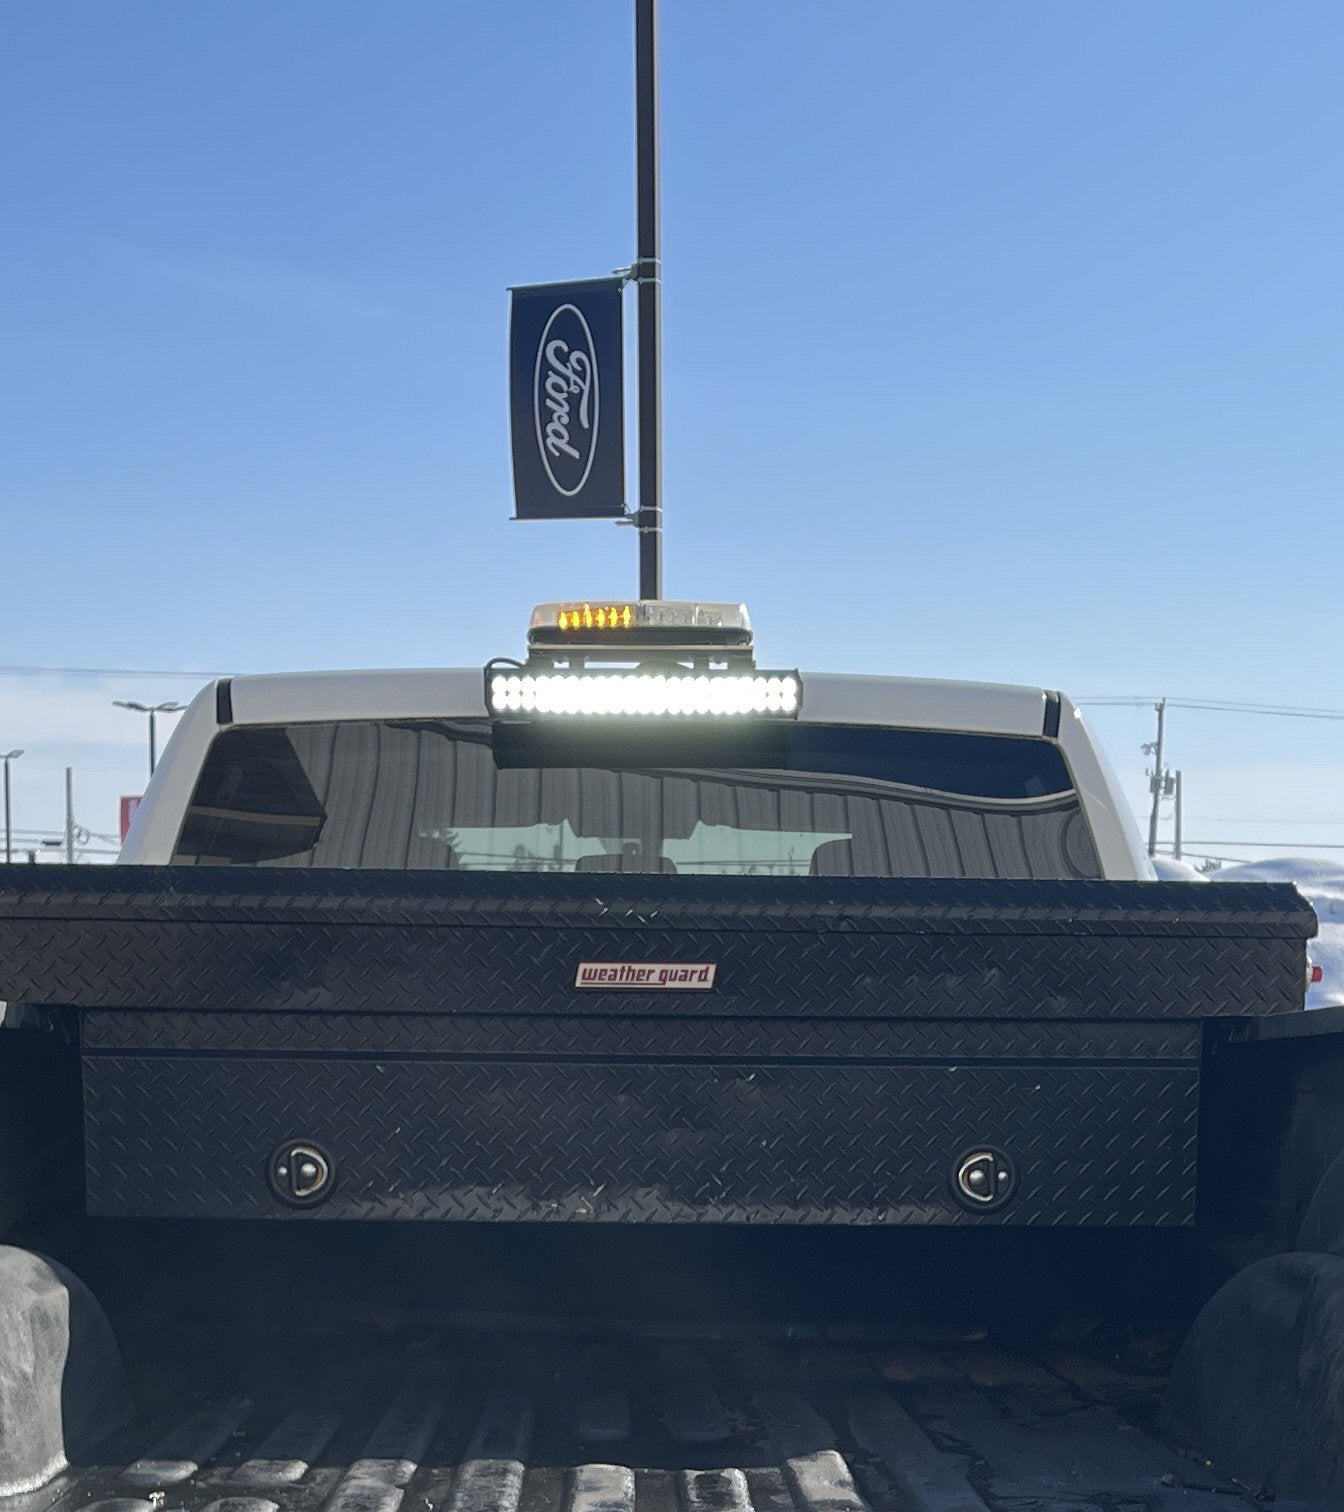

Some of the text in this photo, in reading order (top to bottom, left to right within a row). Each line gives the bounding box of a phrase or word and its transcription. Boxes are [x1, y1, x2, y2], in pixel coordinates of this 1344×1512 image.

[545, 339, 592, 459] Ford
[581, 965, 710, 986] weather guard
